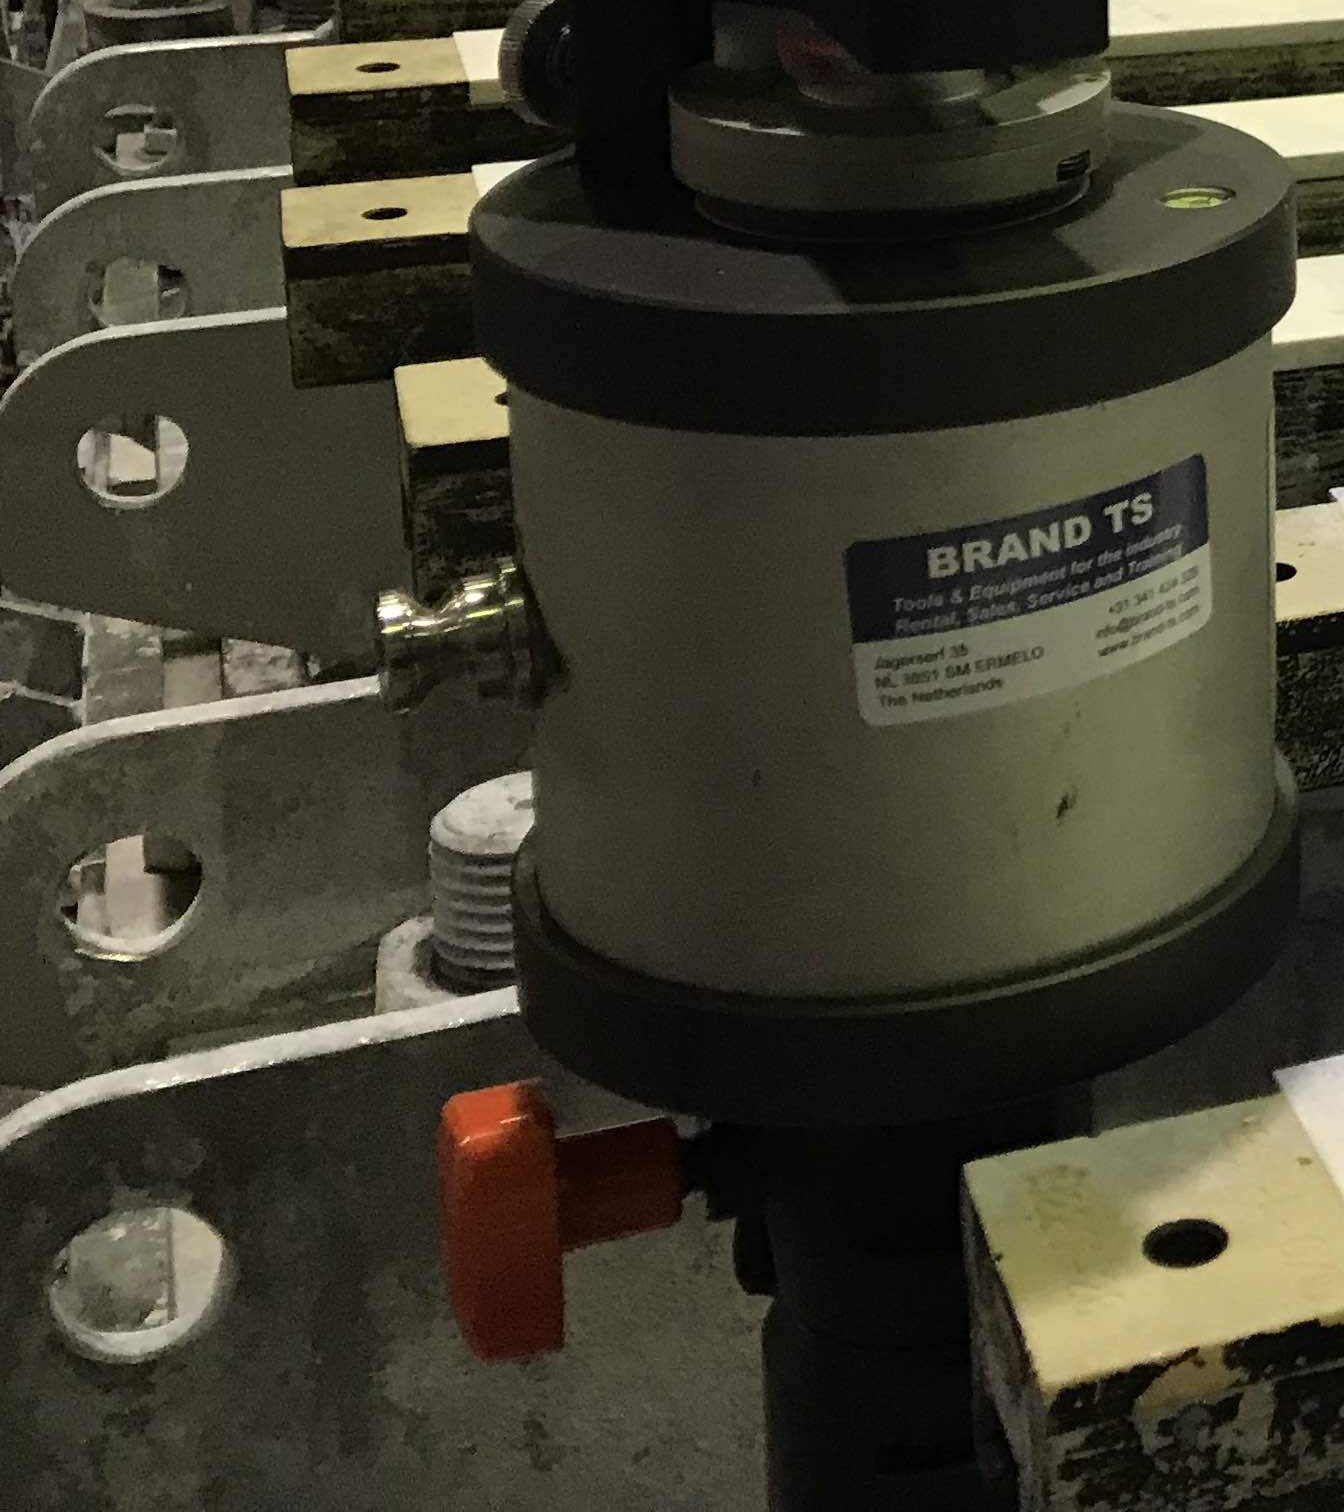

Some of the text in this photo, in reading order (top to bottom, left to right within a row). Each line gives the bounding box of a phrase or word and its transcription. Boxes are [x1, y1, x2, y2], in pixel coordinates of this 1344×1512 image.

[927, 492, 1155, 580] BRAND TS
[893, 594, 945, 614] Tools
[970, 564, 1068, 603] Equipment
[1070, 558, 1094, 576] for
[1097, 549, 1123, 567] the
[1027, 581, 1091, 608] Service
[1094, 565, 1123, 588] and
[974, 646, 1045, 674] ERMELO
[879, 677, 1004, 708] The Netherlands
